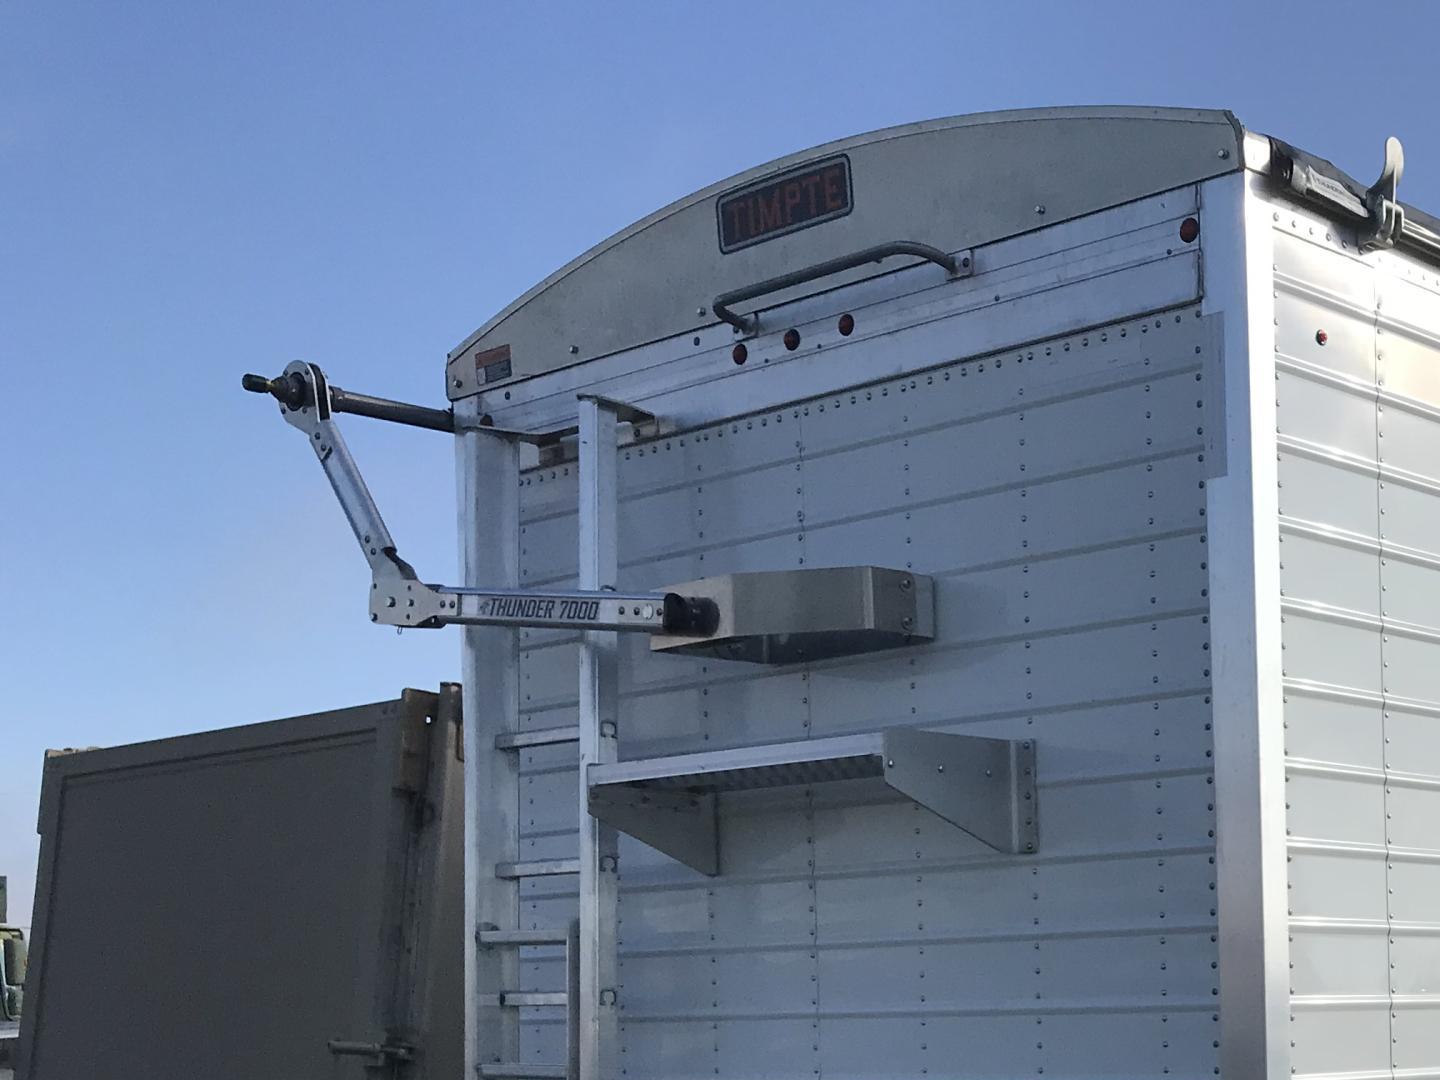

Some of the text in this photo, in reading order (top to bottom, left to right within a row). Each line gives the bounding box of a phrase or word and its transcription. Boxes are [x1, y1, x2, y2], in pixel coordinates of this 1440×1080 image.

[728, 168, 842, 239] TIMPTE
[490, 598, 600, 620] THUNDER 7000
